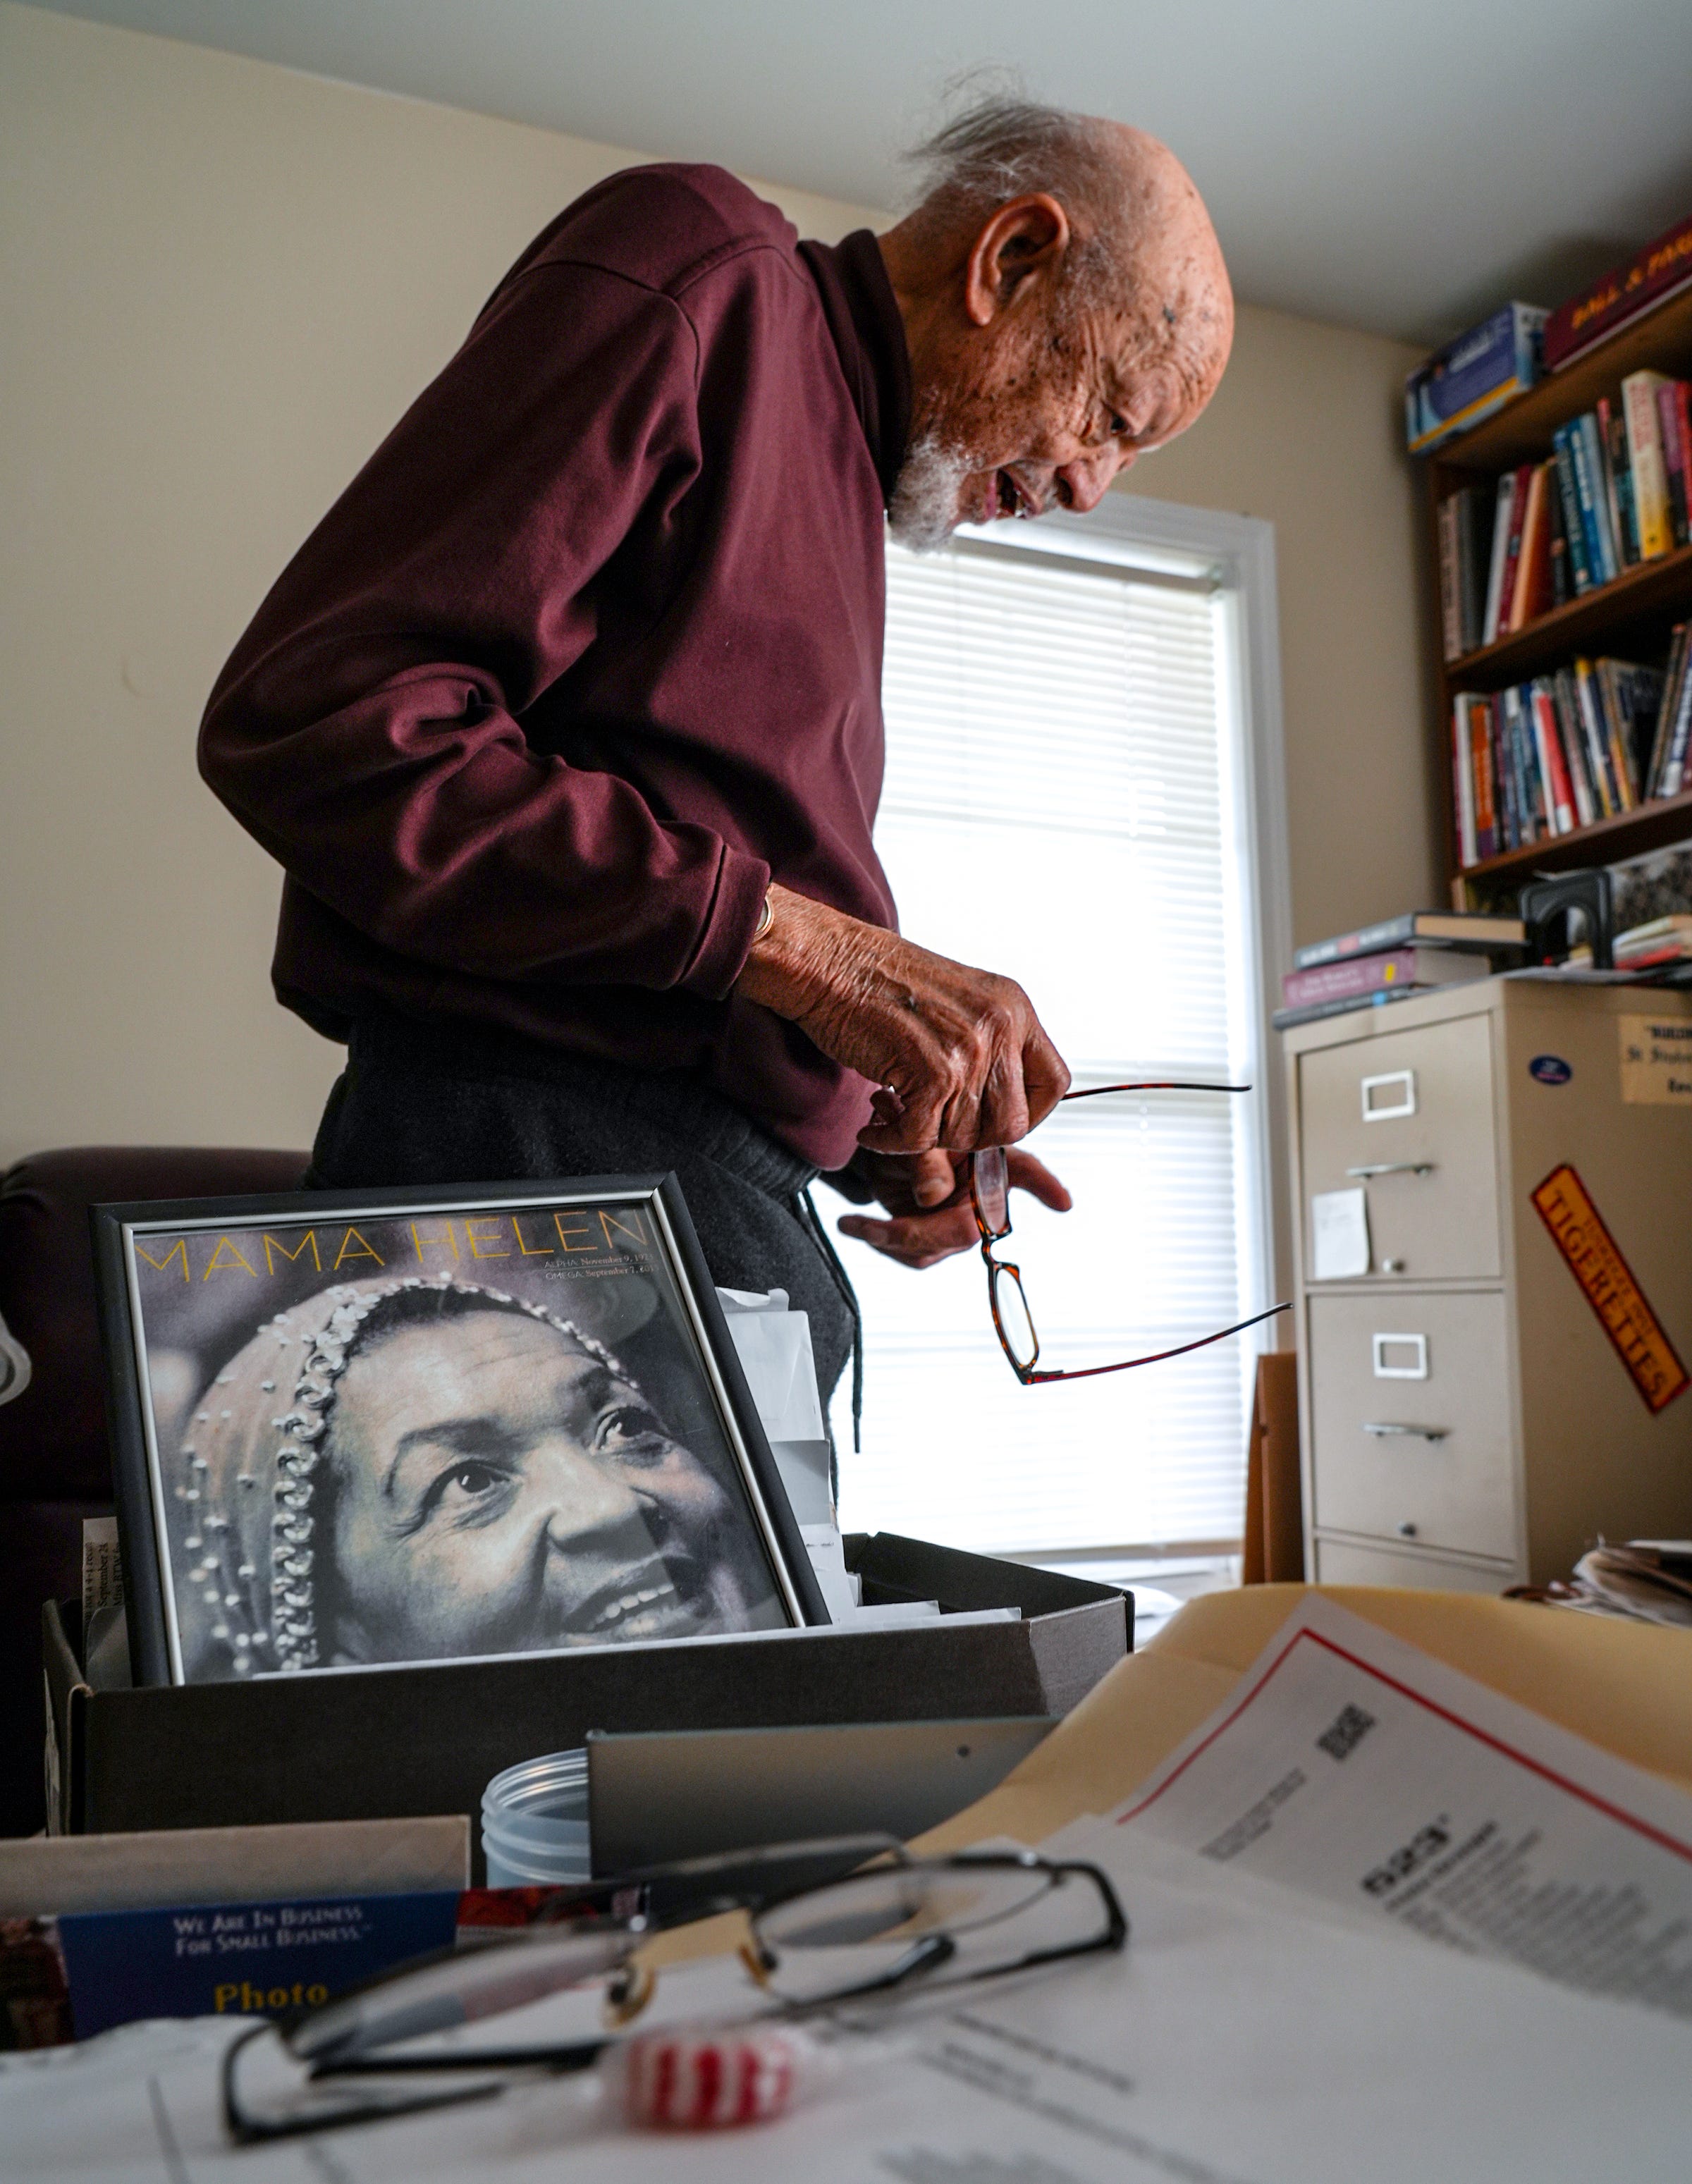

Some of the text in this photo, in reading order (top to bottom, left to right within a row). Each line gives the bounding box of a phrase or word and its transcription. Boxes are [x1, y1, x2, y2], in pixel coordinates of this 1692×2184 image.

[135, 1210, 648, 1282] MAMA HELEN
[580, 1256, 623, 1266] November
[586, 1266, 628, 1278] September
[1548, 1189, 1666, 1396] TIGERETTES
[98, 1552, 110, 1607] September
[214, 1980, 328, 2012] Photo
